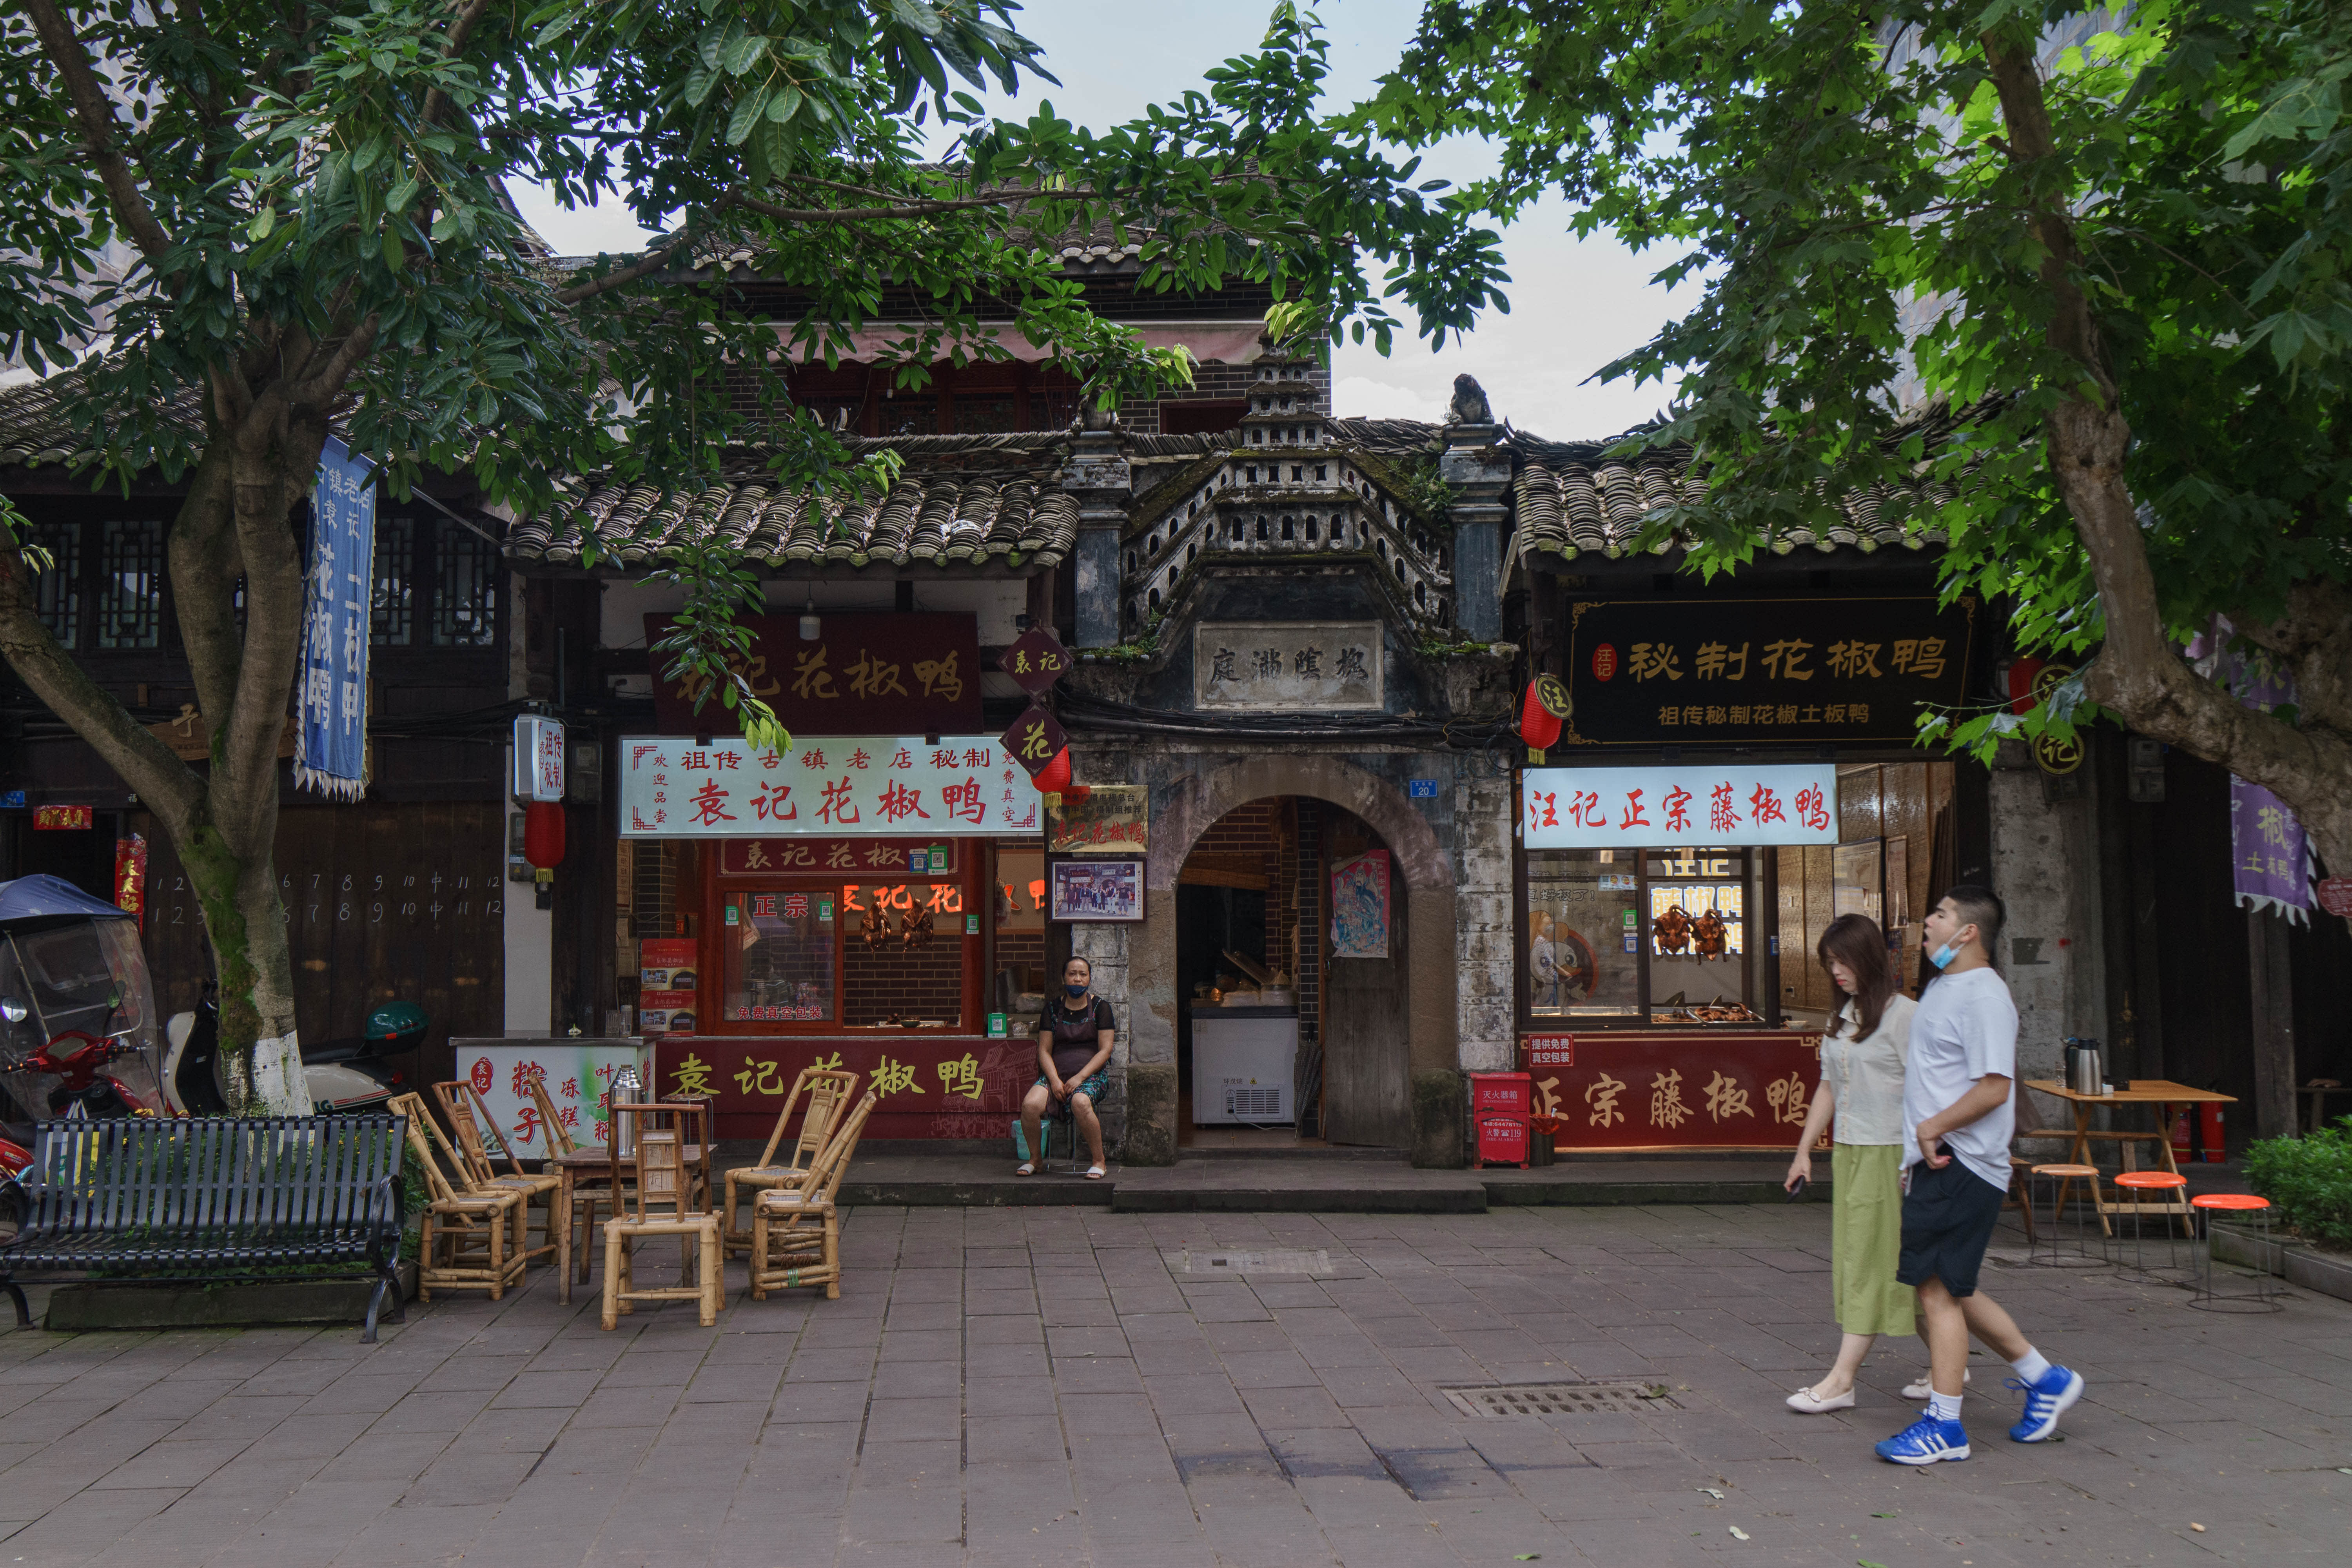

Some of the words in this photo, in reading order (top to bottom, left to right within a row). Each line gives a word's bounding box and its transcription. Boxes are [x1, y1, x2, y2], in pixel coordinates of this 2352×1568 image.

[323, 499, 360, 540] 袁记
[1014, 649, 1061, 674] 袁记
[1597, 649, 1612, 677] 汪记
[1629, 637, 1947, 683] 秘制花椒鸭
[1545, 684, 1568, 710] 汪
[1658, 703, 1869, 726] 祖传秘制花椒土板鸭
[545, 730, 562, 759] 祖传
[1021, 719, 1053, 760] 花
[681, 747, 990, 770] 祖传古镇老店秘制
[544, 761, 561, 788] 秘制
[1001, 751, 1015, 822] 免费真空
[653, 753, 668, 824] 欢迎品尝
[689, 775, 987, 827] 袁记花椒鸭
[1062, 793, 1135, 802] 中央广播电视总台
[1418, 787, 1429, 795] 20
[1055, 805, 1142, 814] 《中国摄制组推荐
[1529, 781, 1831, 833] 汪记正宗藤椒鸭
[1053, 818, 1144, 844] 袁记花椒鸭
[744, 840, 937, 870] 袁记花椒
[1662, 848, 1730, 876] 汪记
[174, 877, 184, 891] 2
[283, 874, 290, 887] 6
[312, 874, 321, 889] 7
[342, 874, 352, 891] 8
[374, 875, 383, 891] 9
[403, 875, 415, 887] 10
[457, 876, 469, 889] 11
[487, 876, 499, 887] 12
[172, 906, 185, 924] 2
[307, 904, 319, 924] 7
[339, 904, 350, 921] 8
[372, 902, 383, 924] 9
[402, 903, 416, 915] 10
[430, 900, 444, 920] 中
[457, 901, 469, 915] 11
[486, 900, 502, 918] 12
[753, 893, 809, 918] 正宗
[1651, 886, 1742, 919] 藤椒鸭
[737, 1005, 822, 1020] 免费真空包装
[1532, 1039, 1570, 1050] 提供免费
[1532, 1052, 1570, 1063] 真空包装
[476, 1064, 488, 1089] 袁记
[669, 1051, 984, 1100] 袁记花椒鸭
[512, 1060, 548, 1144] 粽子
[561, 1077, 581, 1128] 冻糕
[1483, 1090, 1518, 1099] 灭火器箱
[1532, 1068, 1811, 1129] 正宗藤椒鸭
[1486, 1128, 1500, 1137] 火警
[1510, 1129, 1521, 1138] 119
